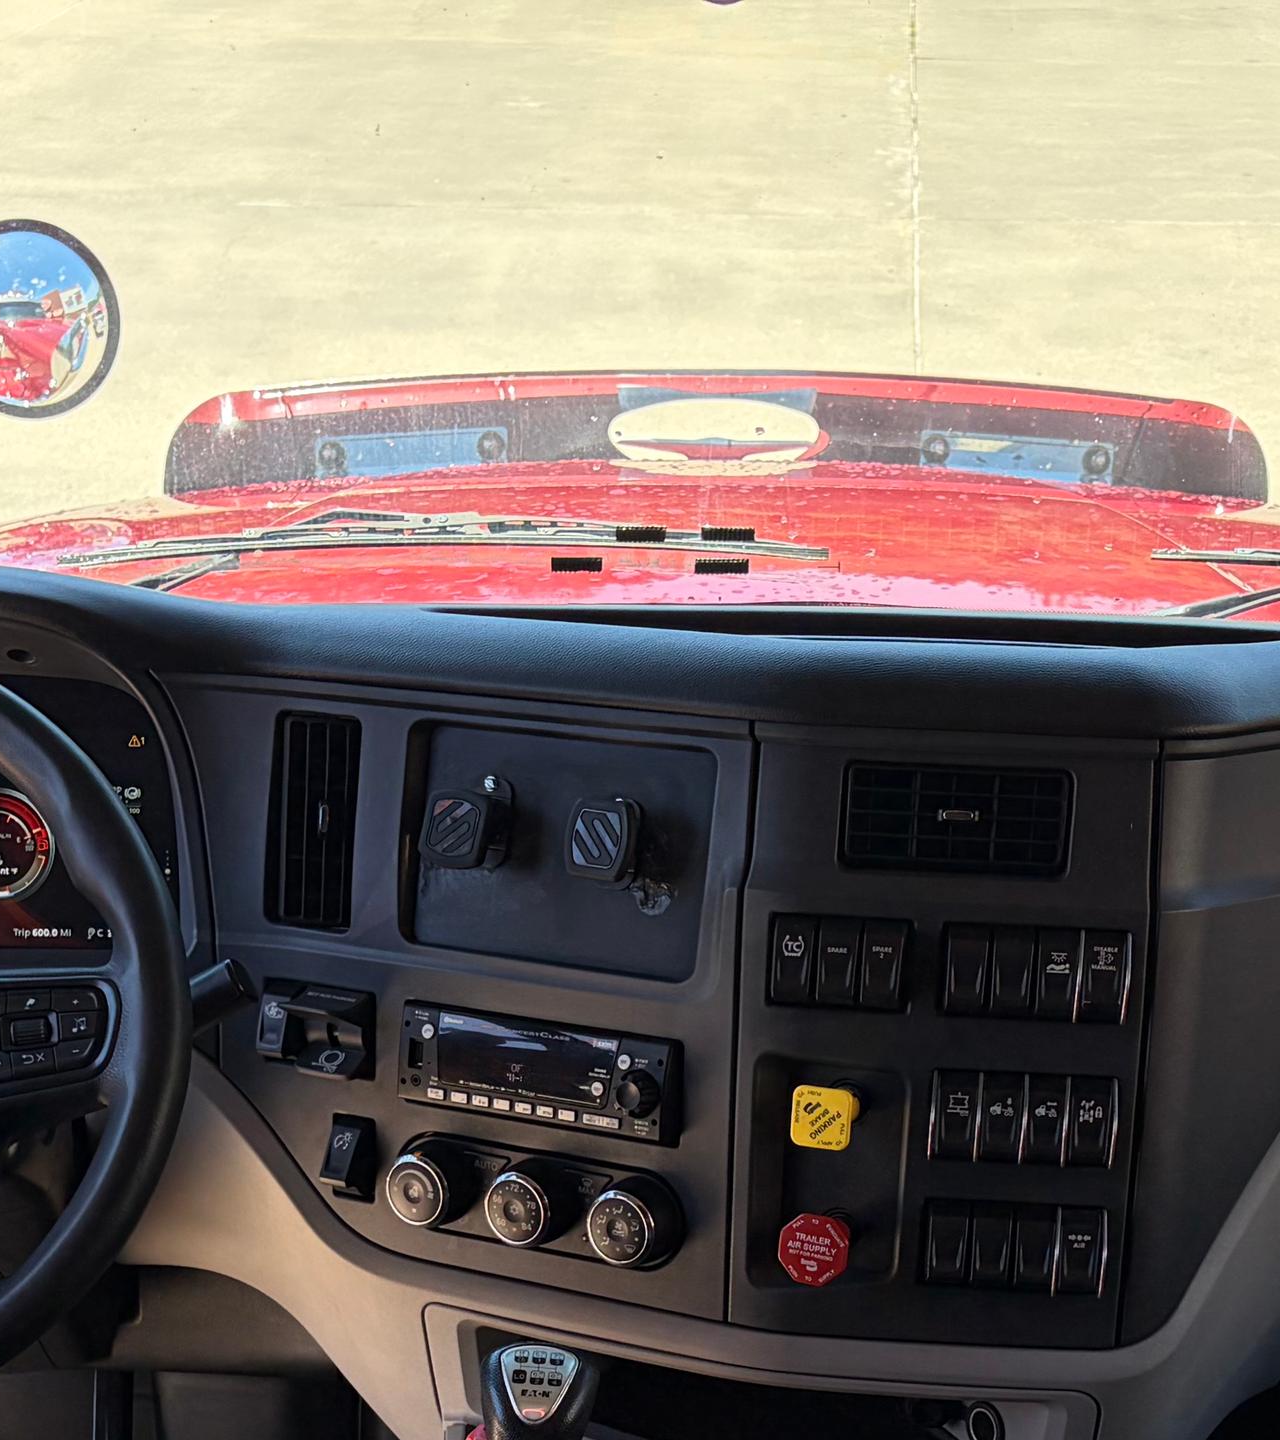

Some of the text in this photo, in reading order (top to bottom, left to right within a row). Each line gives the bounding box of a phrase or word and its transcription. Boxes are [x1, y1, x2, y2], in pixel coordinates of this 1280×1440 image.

[13, 928, 72, 940] Trip 600.0 MI
[827, 946, 848, 954] SPARE
[872, 945, 893, 953] SPARE
[808, 1108, 830, 1127] BRAKE
[809, 1110, 842, 1140] PARKING
[473, 1159, 498, 1172] AUTO
[510, 1184, 520, 1192] 72
[795, 1231, 831, 1246] TRAILER
[787, 1240, 837, 1256] AIR SUPPLY
